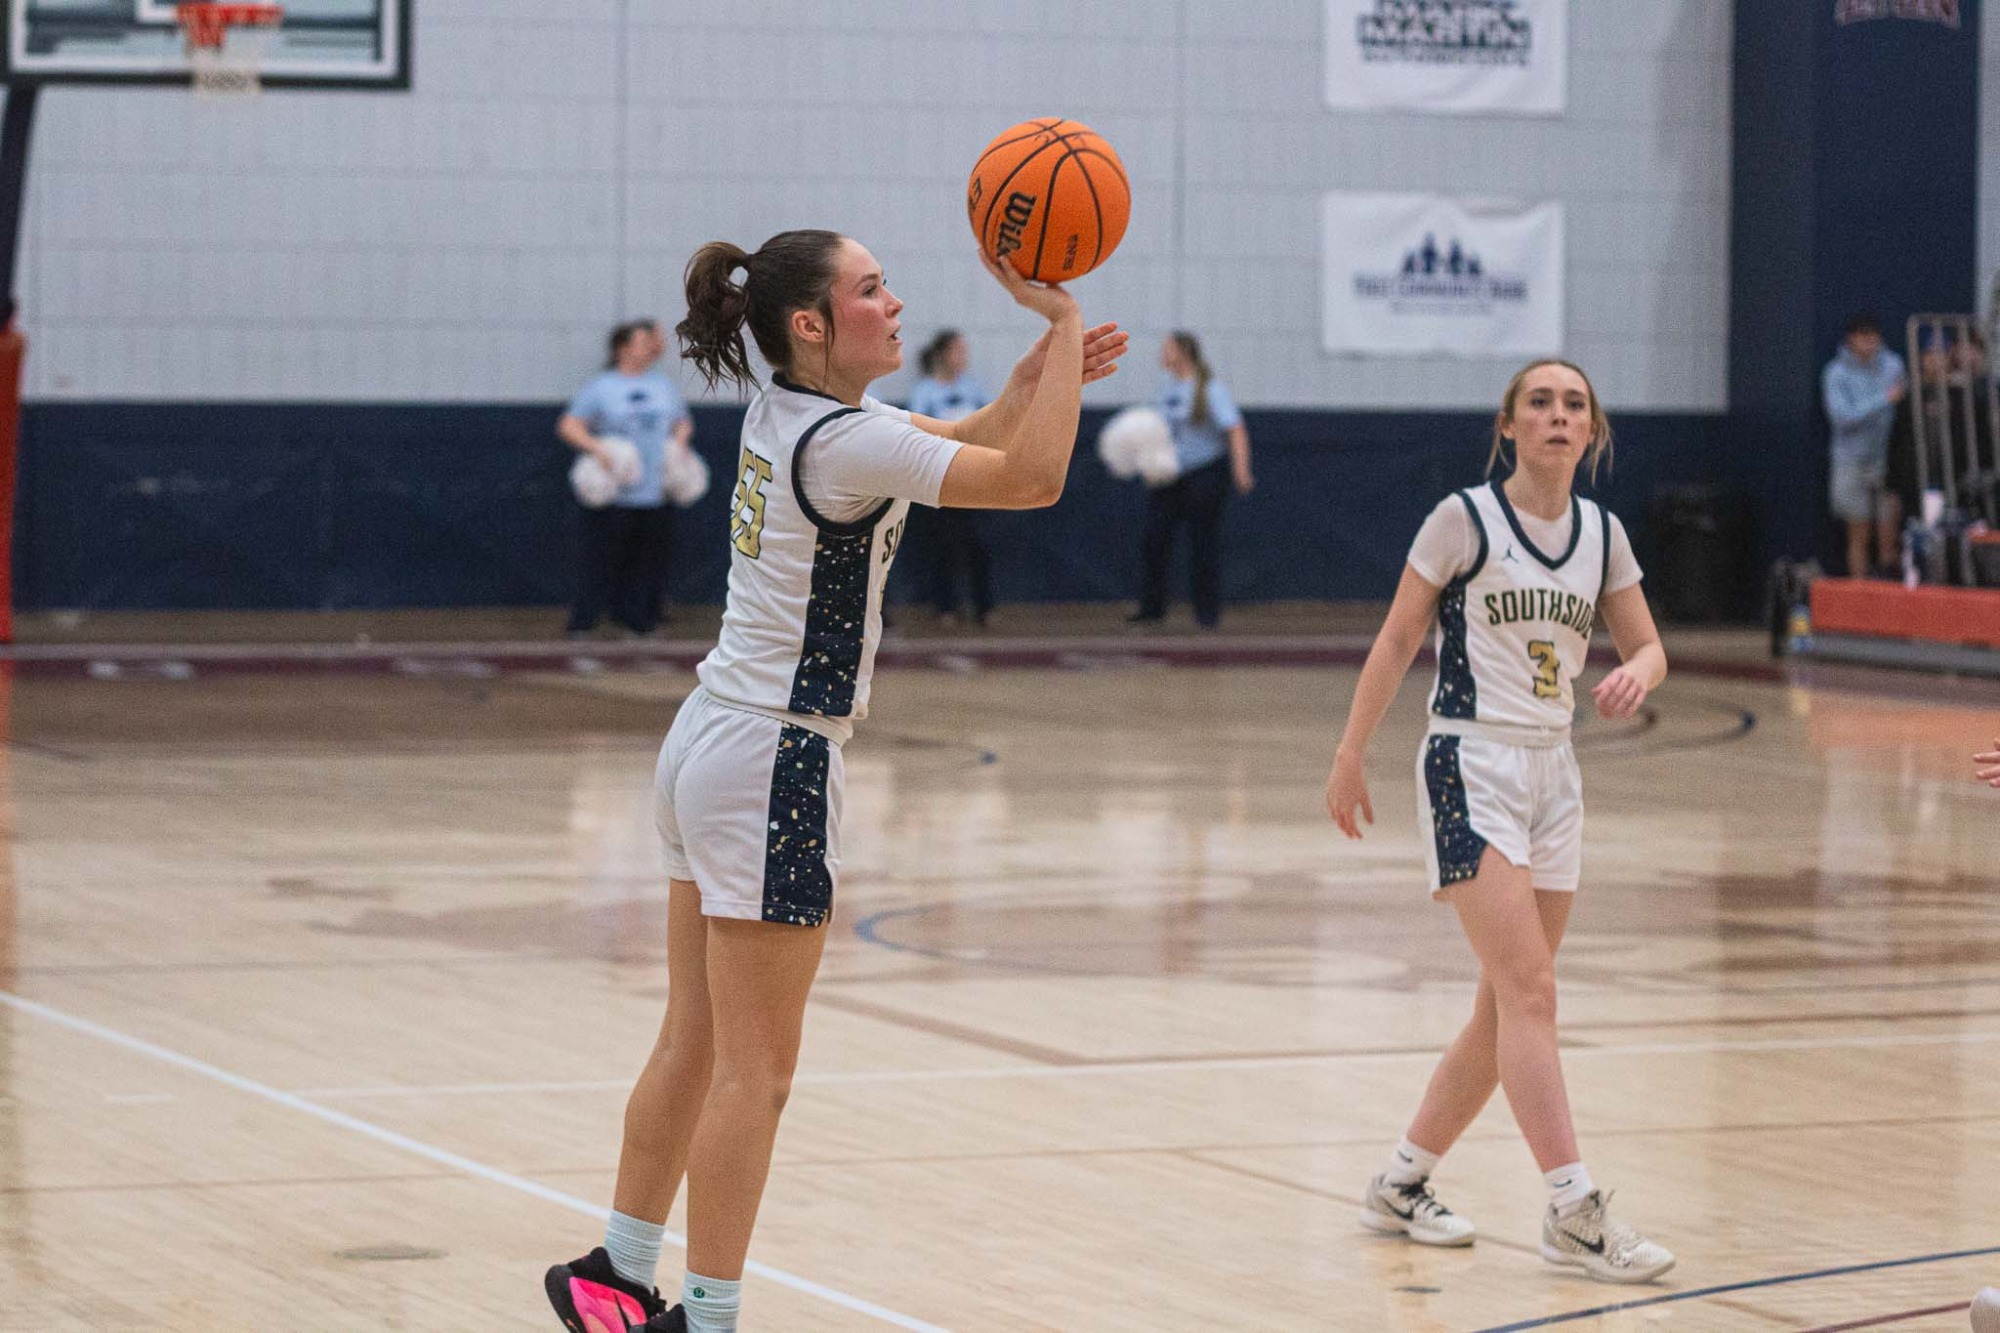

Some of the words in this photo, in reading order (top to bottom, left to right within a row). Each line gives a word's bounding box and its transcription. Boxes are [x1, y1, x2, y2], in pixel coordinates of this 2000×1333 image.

[730, 446, 773, 560] 55
[1484, 587, 1595, 640] SOUTHSID
[1527, 639, 1562, 698] 3
